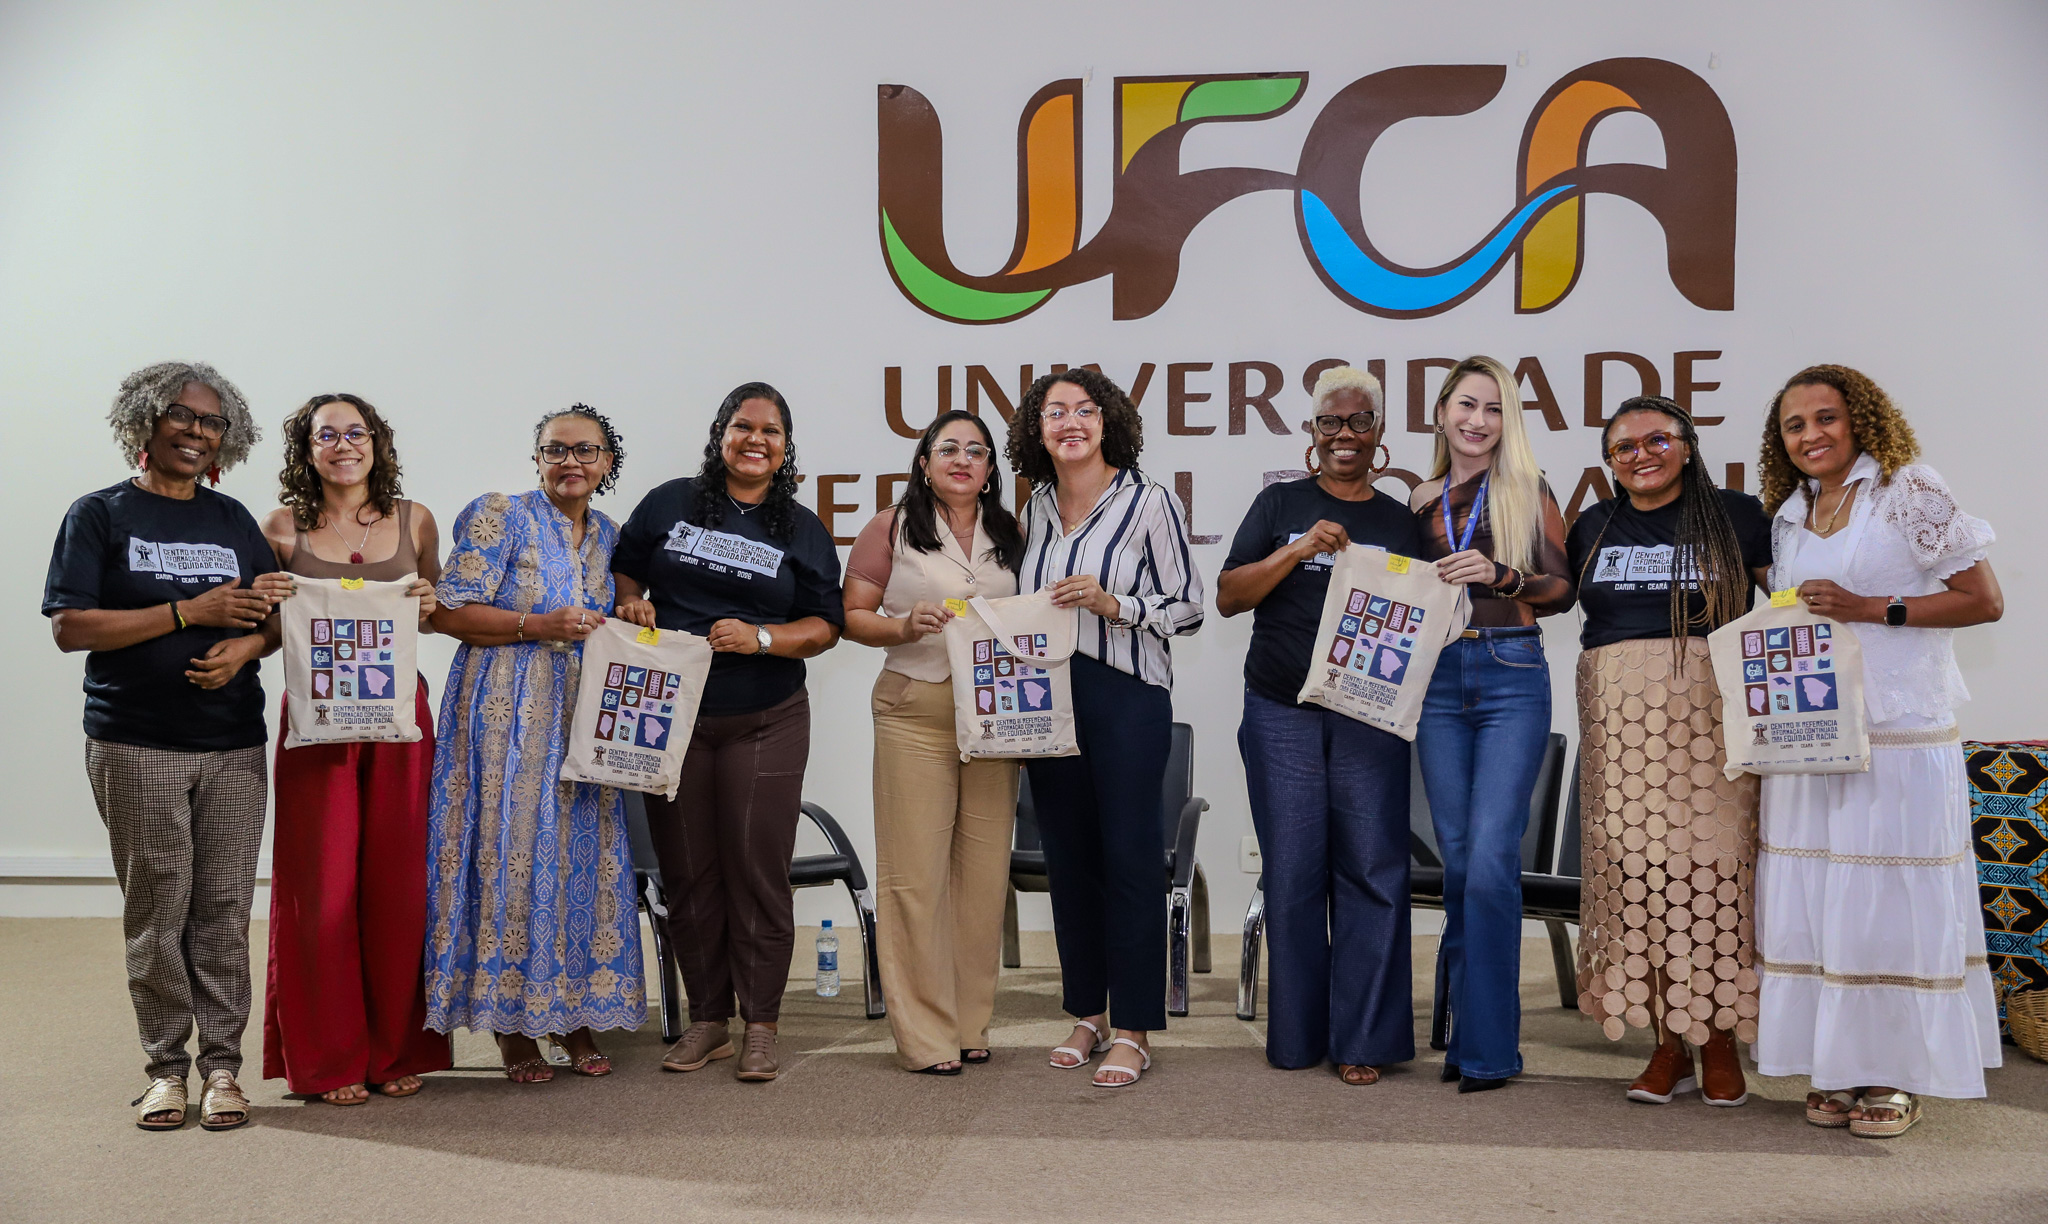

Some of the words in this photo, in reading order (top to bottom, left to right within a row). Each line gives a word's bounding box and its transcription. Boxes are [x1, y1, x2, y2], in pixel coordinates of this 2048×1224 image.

[878, 57, 1737, 323] UFCA
[705, 534, 732, 546] CENTRO
[713, 548, 749, 563] EQUIDADE
[750, 557, 776, 570] RACIAL
[708, 561, 728, 573] CEARÁ
[1648, 582, 1667, 590] CEARÁ
